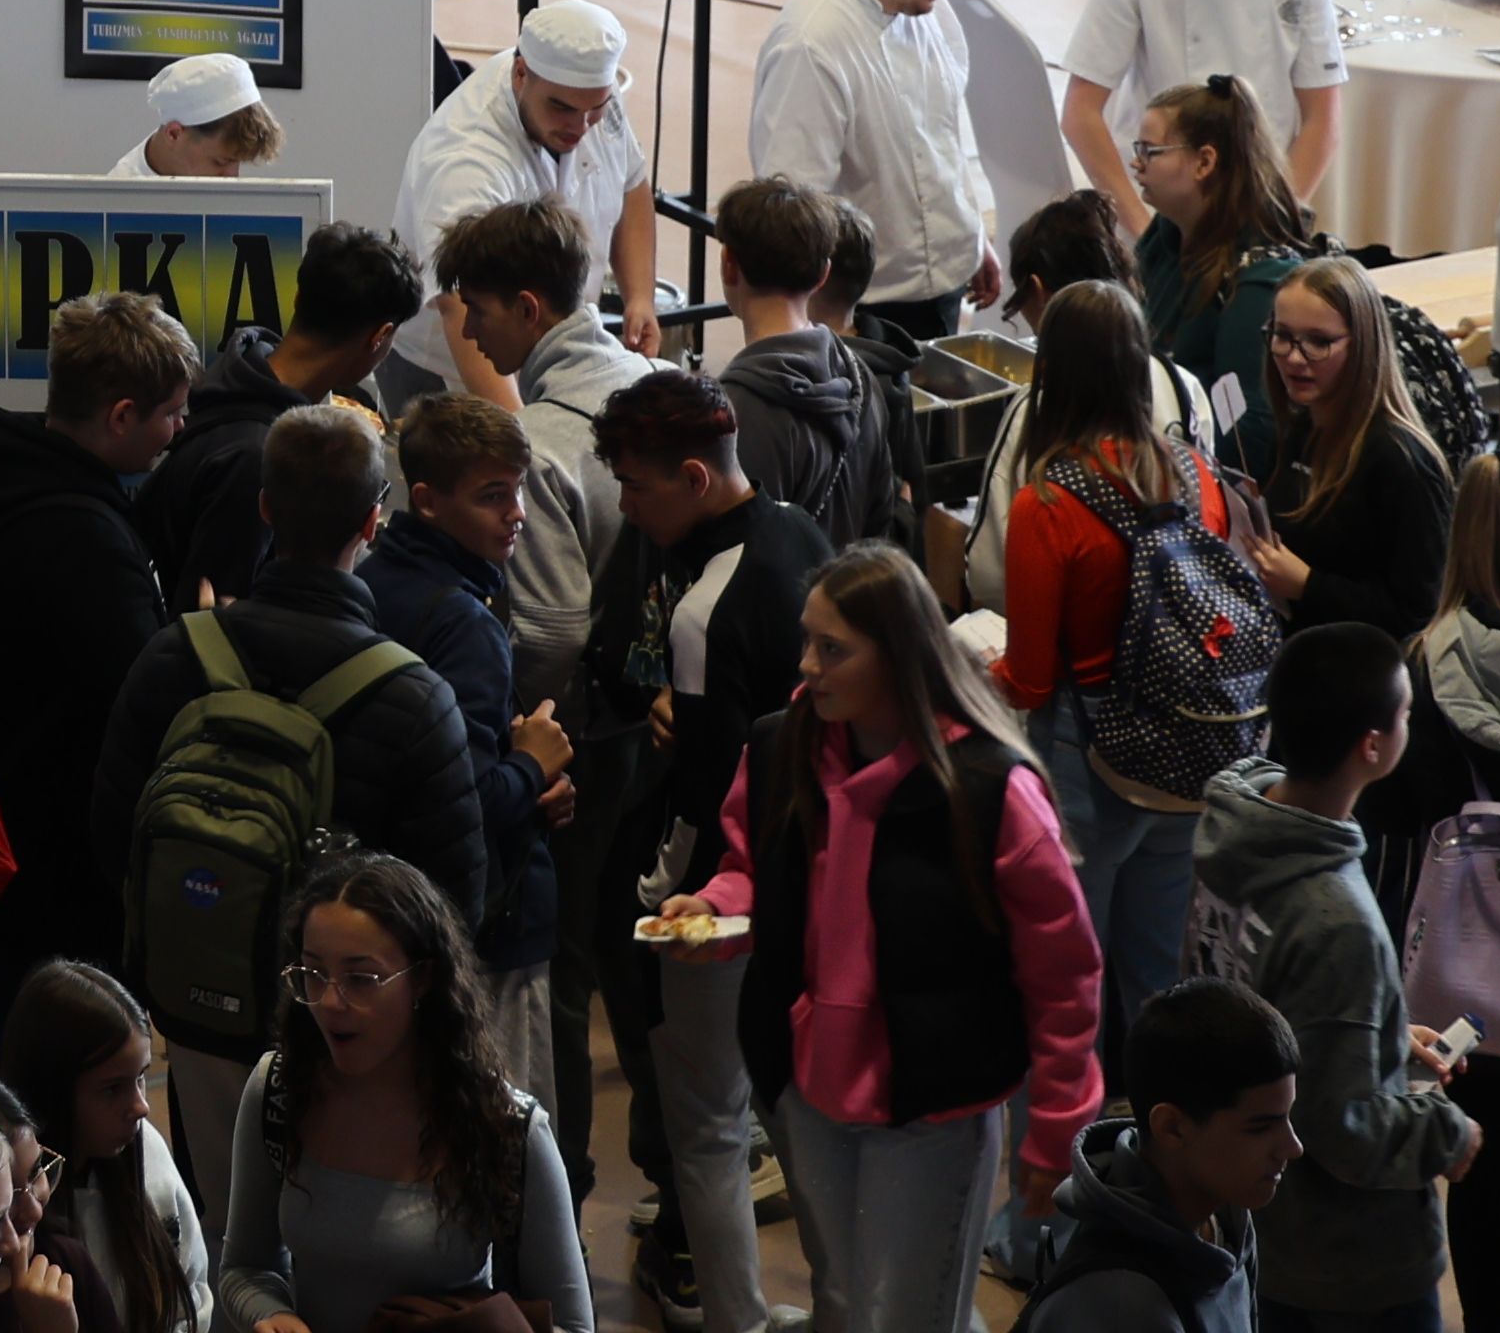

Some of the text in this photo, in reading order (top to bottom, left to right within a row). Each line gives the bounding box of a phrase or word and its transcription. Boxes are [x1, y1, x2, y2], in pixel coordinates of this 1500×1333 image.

[91, 23, 144, 39] TURIZMUS
[236, 27, 276, 47] ÁGAZAT
[183, 878, 220, 896] NASA
[189, 986, 224, 1010] PASO
